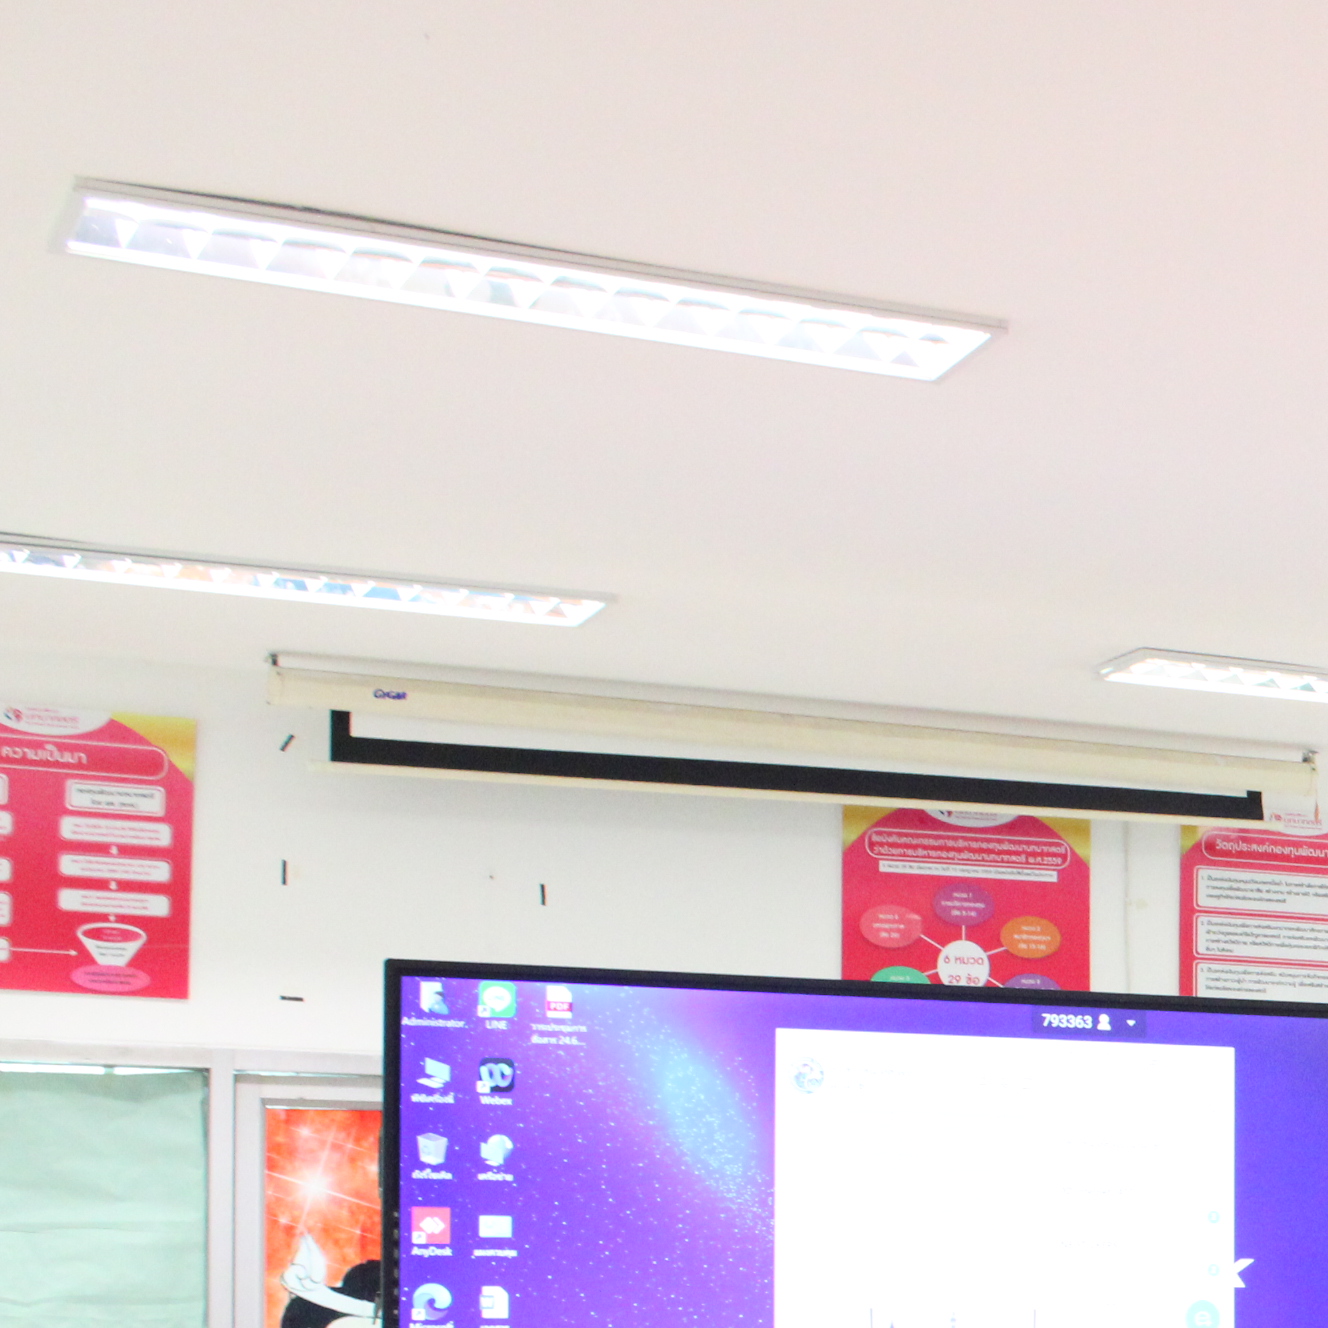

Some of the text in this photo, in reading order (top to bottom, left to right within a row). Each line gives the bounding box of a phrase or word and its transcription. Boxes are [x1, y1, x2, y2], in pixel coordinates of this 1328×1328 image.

[1, 743, 88, 764] ความเป็นมา
[944, 955, 984, 966] 6 หมวด
[948, 975, 961, 984] 29
[550, 1002, 570, 1010] PDF
[485, 1020, 508, 1030] LINE
[1041, 1013, 1093, 1029] 793363
[411, 1246, 453, 1257] AnyDesk
